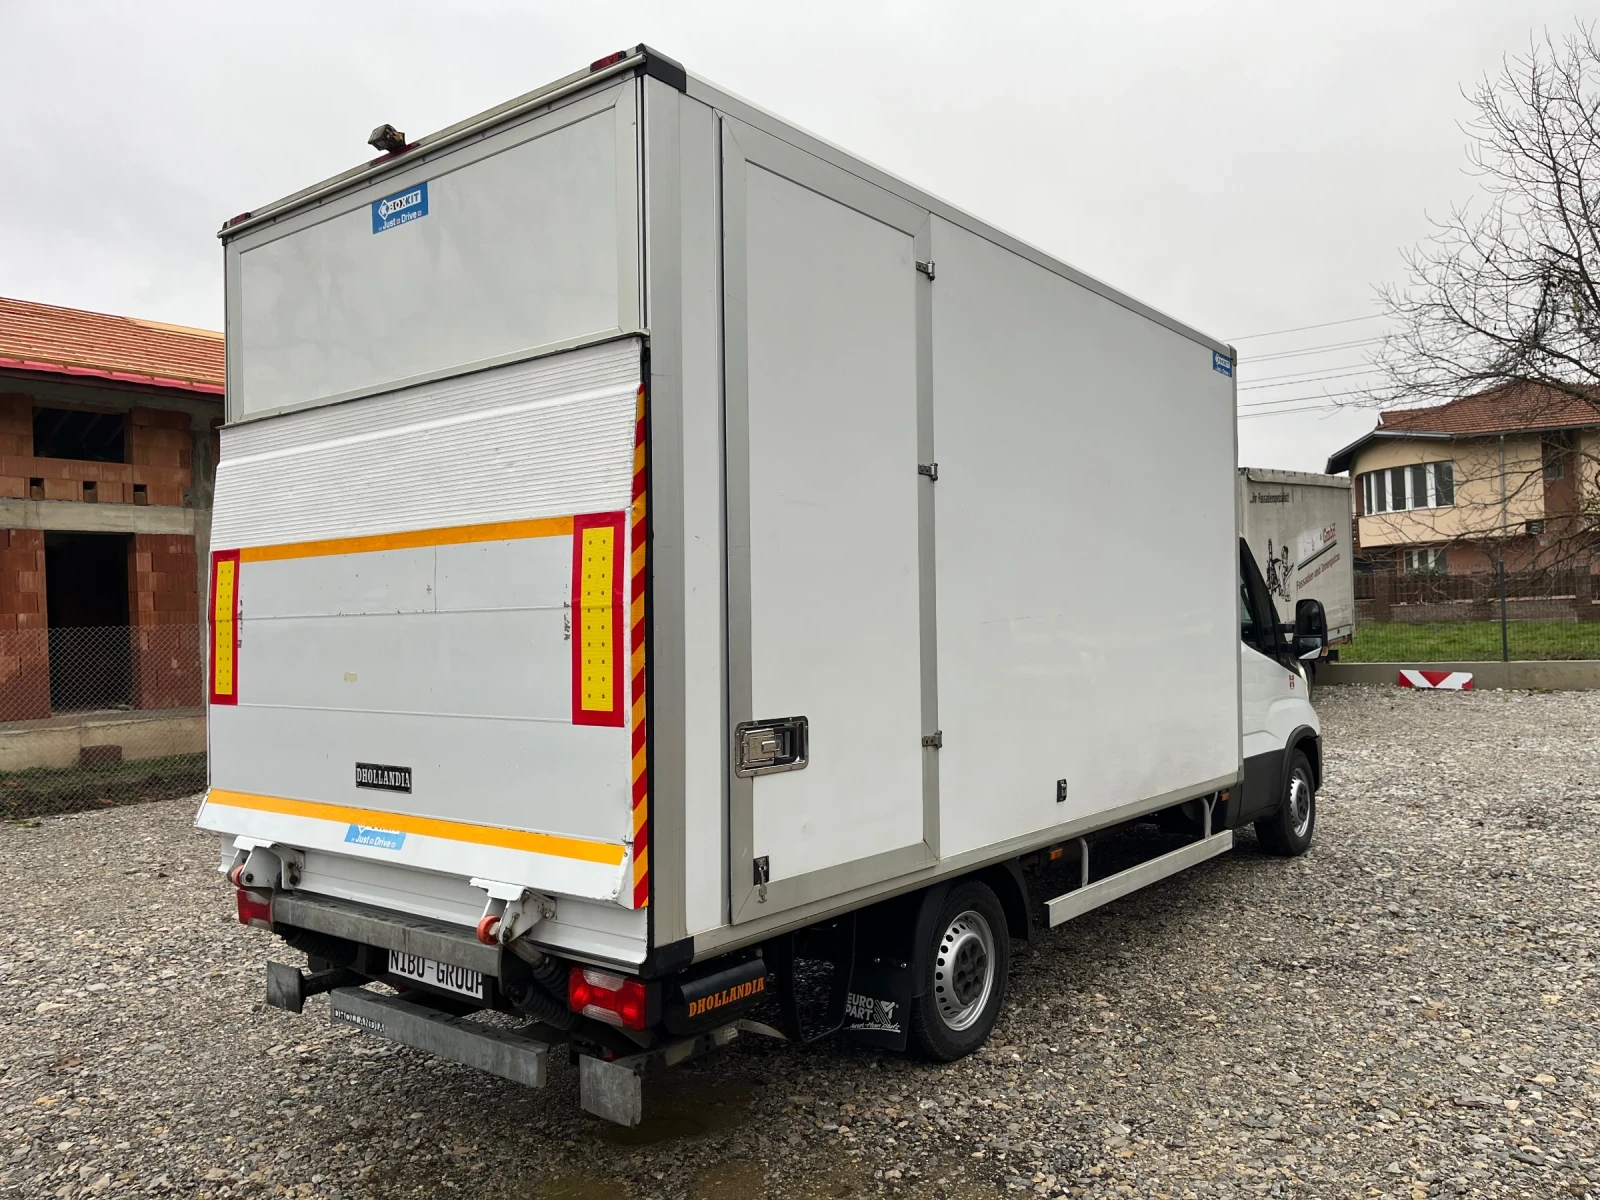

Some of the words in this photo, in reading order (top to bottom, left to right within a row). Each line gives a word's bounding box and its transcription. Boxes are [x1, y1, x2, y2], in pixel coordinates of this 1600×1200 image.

[382, 218, 396, 230] Just
[401, 211, 417, 223] Drive
[356, 767, 411, 788] DHOLLANDIA
[355, 833, 369, 845] Just
[373, 836, 392, 848] Drive
[688, 977, 765, 1018] DHOLLANDIA
[847, 992, 875, 1010] EURO
[845, 1003, 874, 1021] PART
